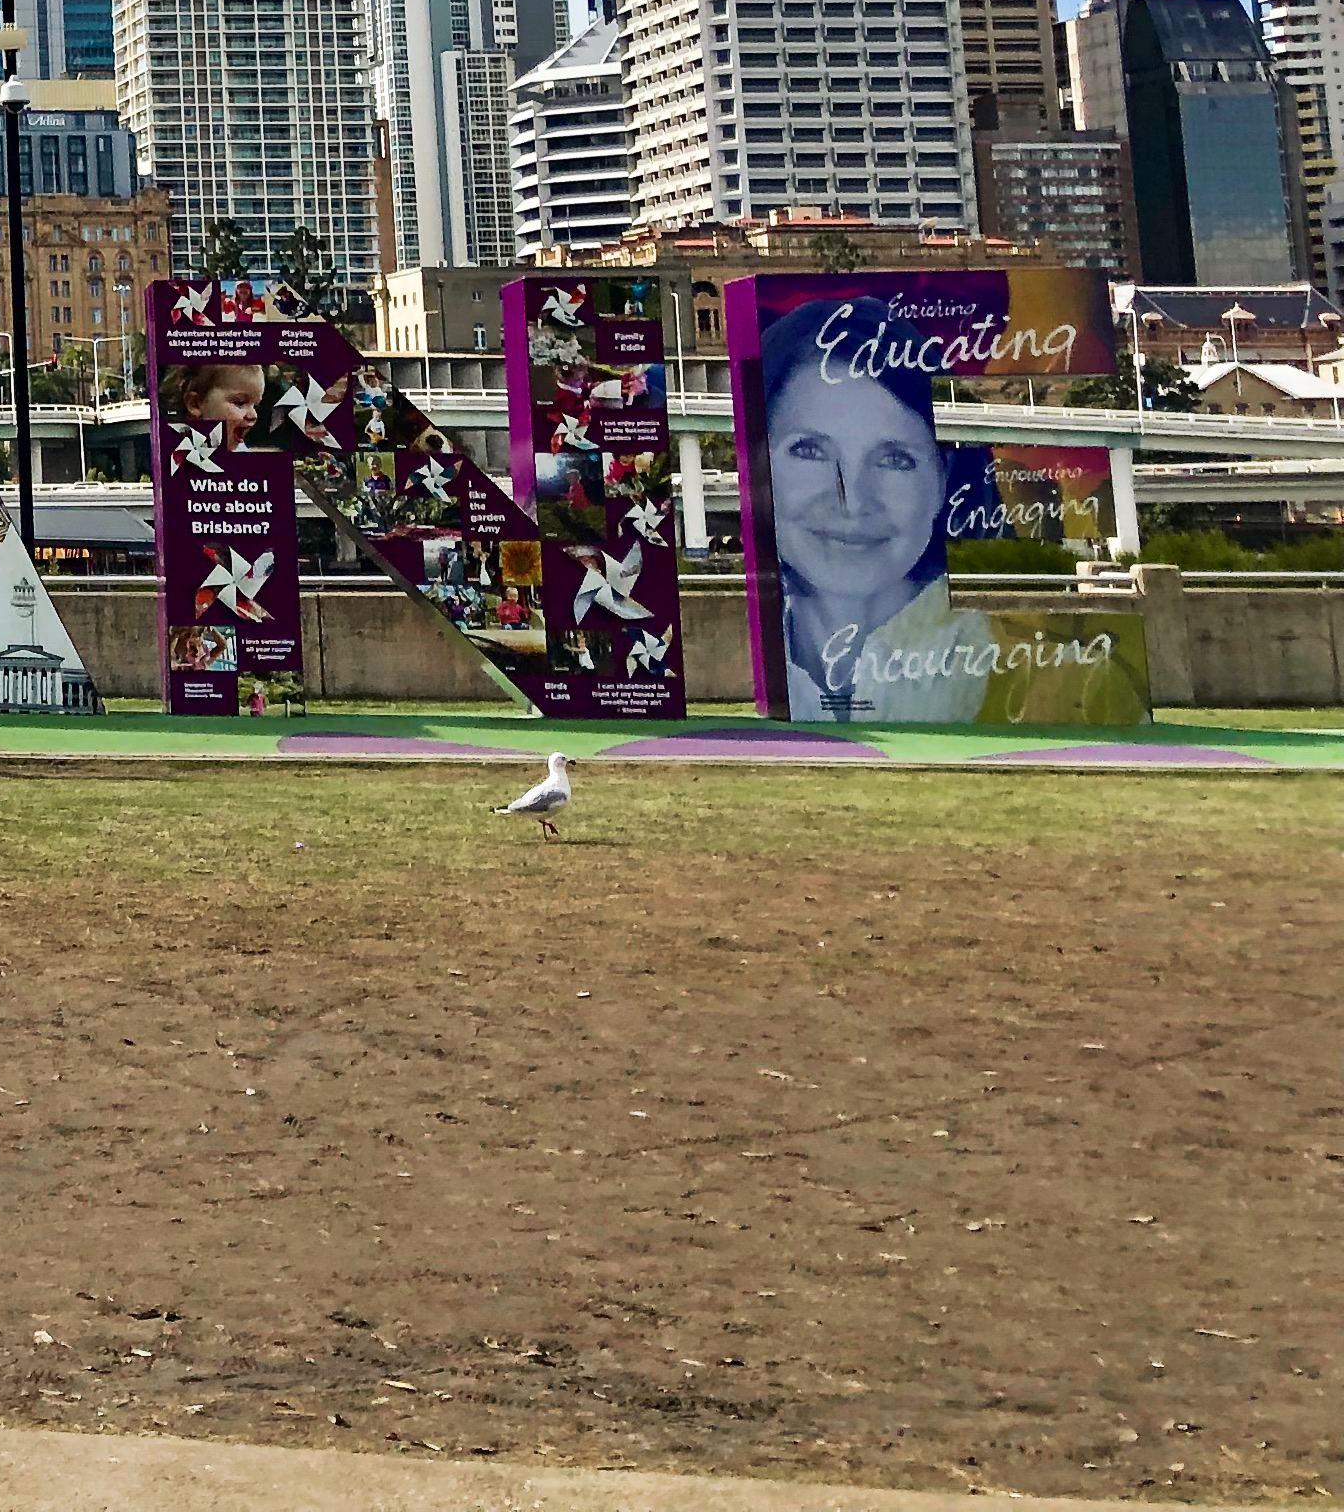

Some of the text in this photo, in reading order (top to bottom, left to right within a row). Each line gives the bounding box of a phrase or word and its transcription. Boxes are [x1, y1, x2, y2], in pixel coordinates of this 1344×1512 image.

[887, 292, 979, 332] Enriching
[166, 329, 262, 338] Adventures under blue
[281, 329, 314, 339] Playing
[614, 332, 645, 342] Family
[168, 339, 261, 349] skies and in big green
[278, 339, 317, 348] outdoors
[620, 344, 646, 352] Eddie
[815, 303, 1077, 385] Educating
[182, 349, 212, 358] spaces
[219, 349, 247, 357] Brodie
[189, 478, 268, 492] What do I
[468, 480, 472, 488] I
[468, 490, 487, 499] like
[187, 499, 273, 513] love about
[469, 502, 486, 511] the
[470, 513, 506, 523] garden
[947, 483, 1099, 544] Engaging
[191, 521, 270, 534] Brisbane?
[477, 524, 501, 534] Amy
[821, 623, 1113, 724] Encouraging
[544, 682, 568, 690] Birds
[550, 692, 571, 701] Lara
